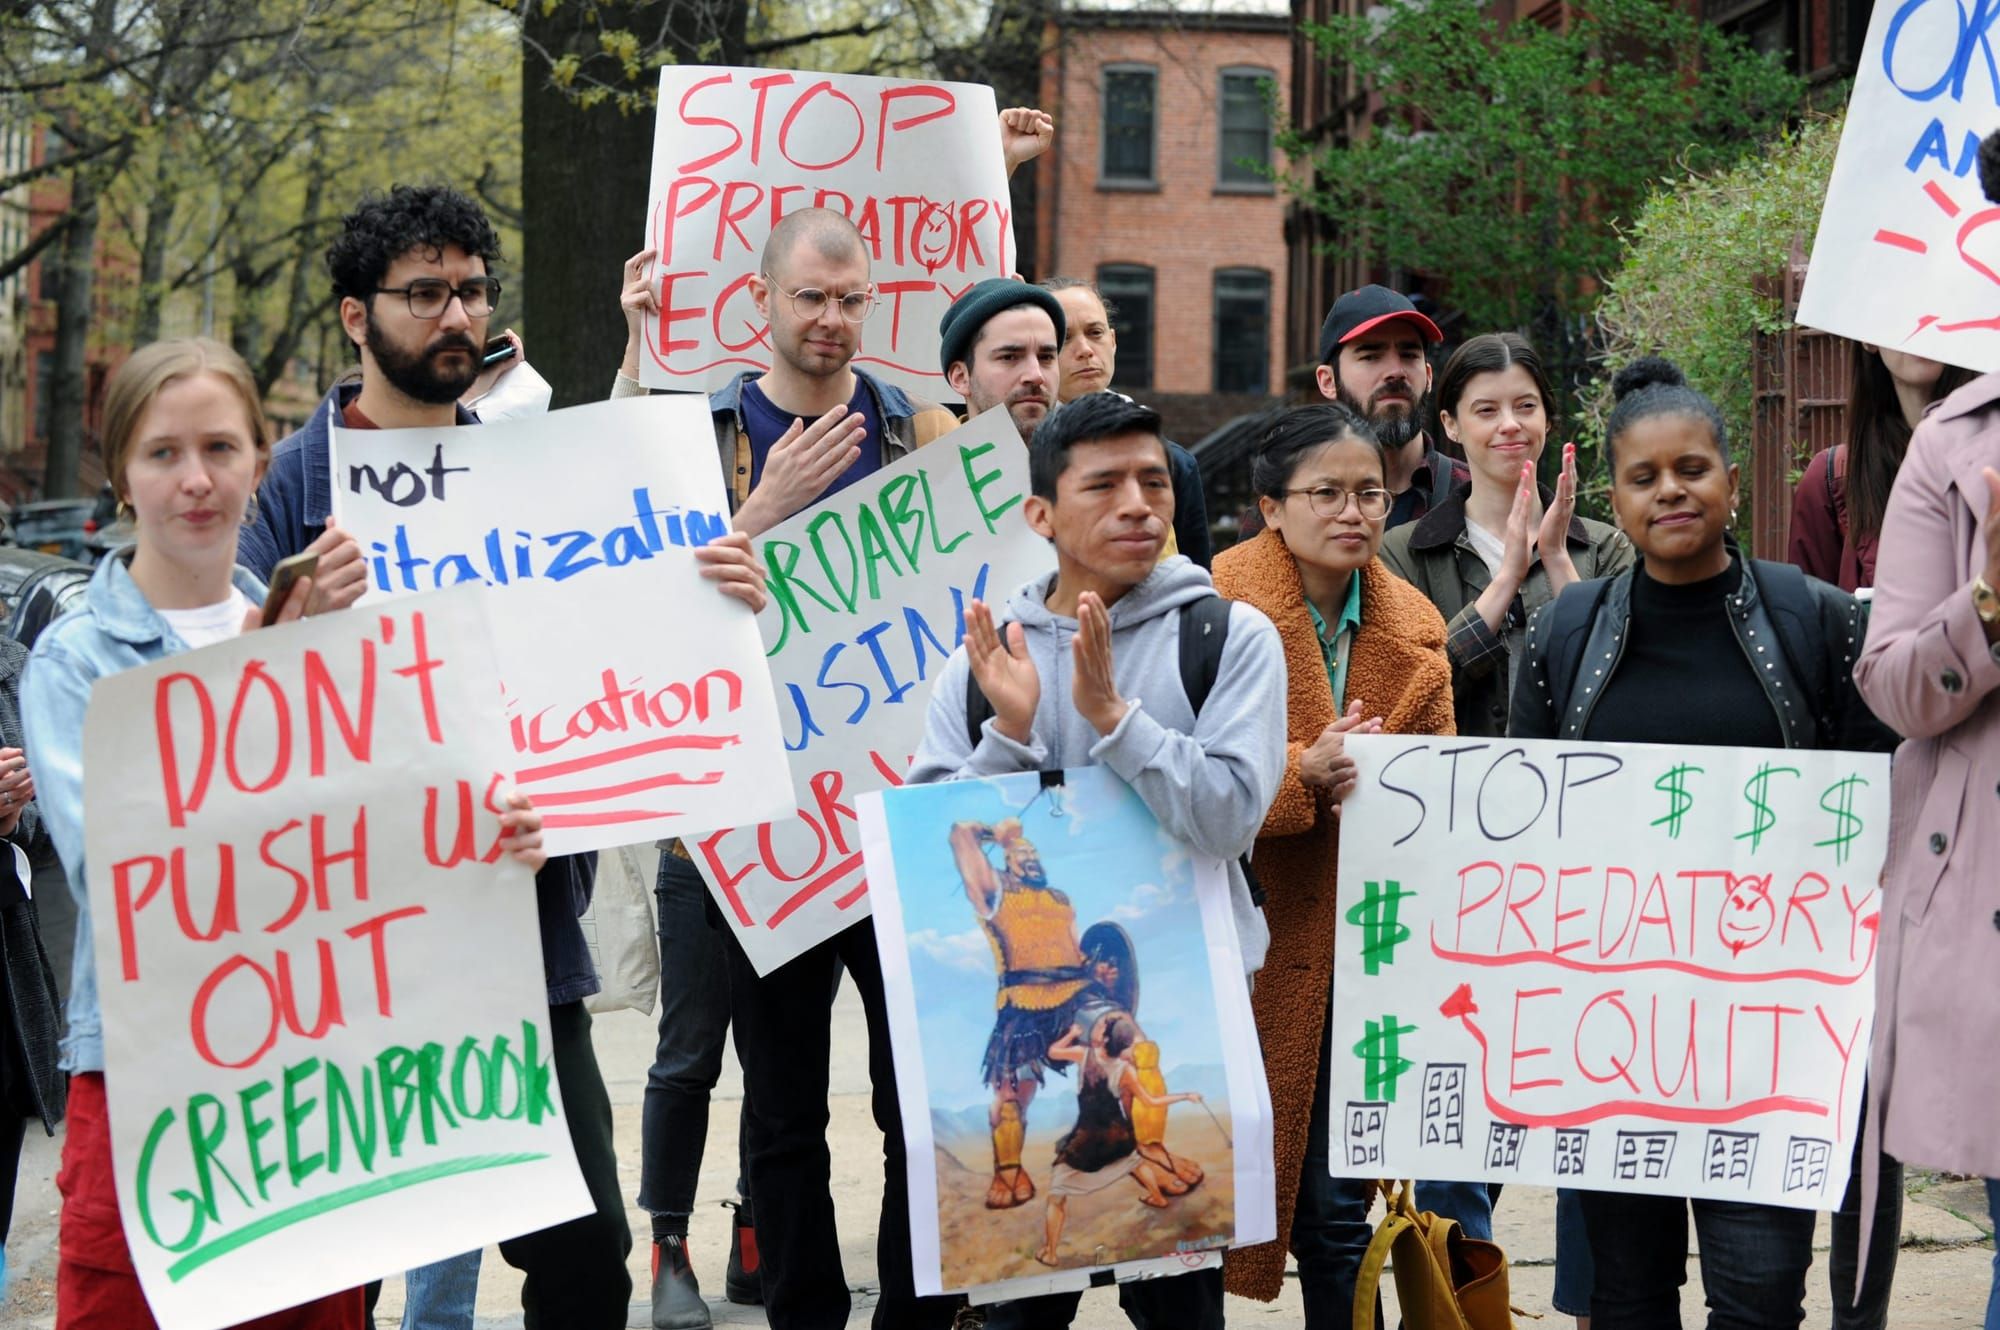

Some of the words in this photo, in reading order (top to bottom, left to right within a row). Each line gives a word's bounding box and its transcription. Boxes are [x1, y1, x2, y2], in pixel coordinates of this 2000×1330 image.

[679, 73, 956, 174] STOP
[350, 443, 470, 508] not
[504, 668, 743, 755] ication
[1379, 744, 1624, 848] STOP
[111, 804, 369, 983] PUSH
[697, 770, 859, 928] FOR
[1457, 860, 1875, 962] PREDATORY
[190, 905, 428, 1069] OUT
[1510, 986, 1862, 1144] EQUITY
